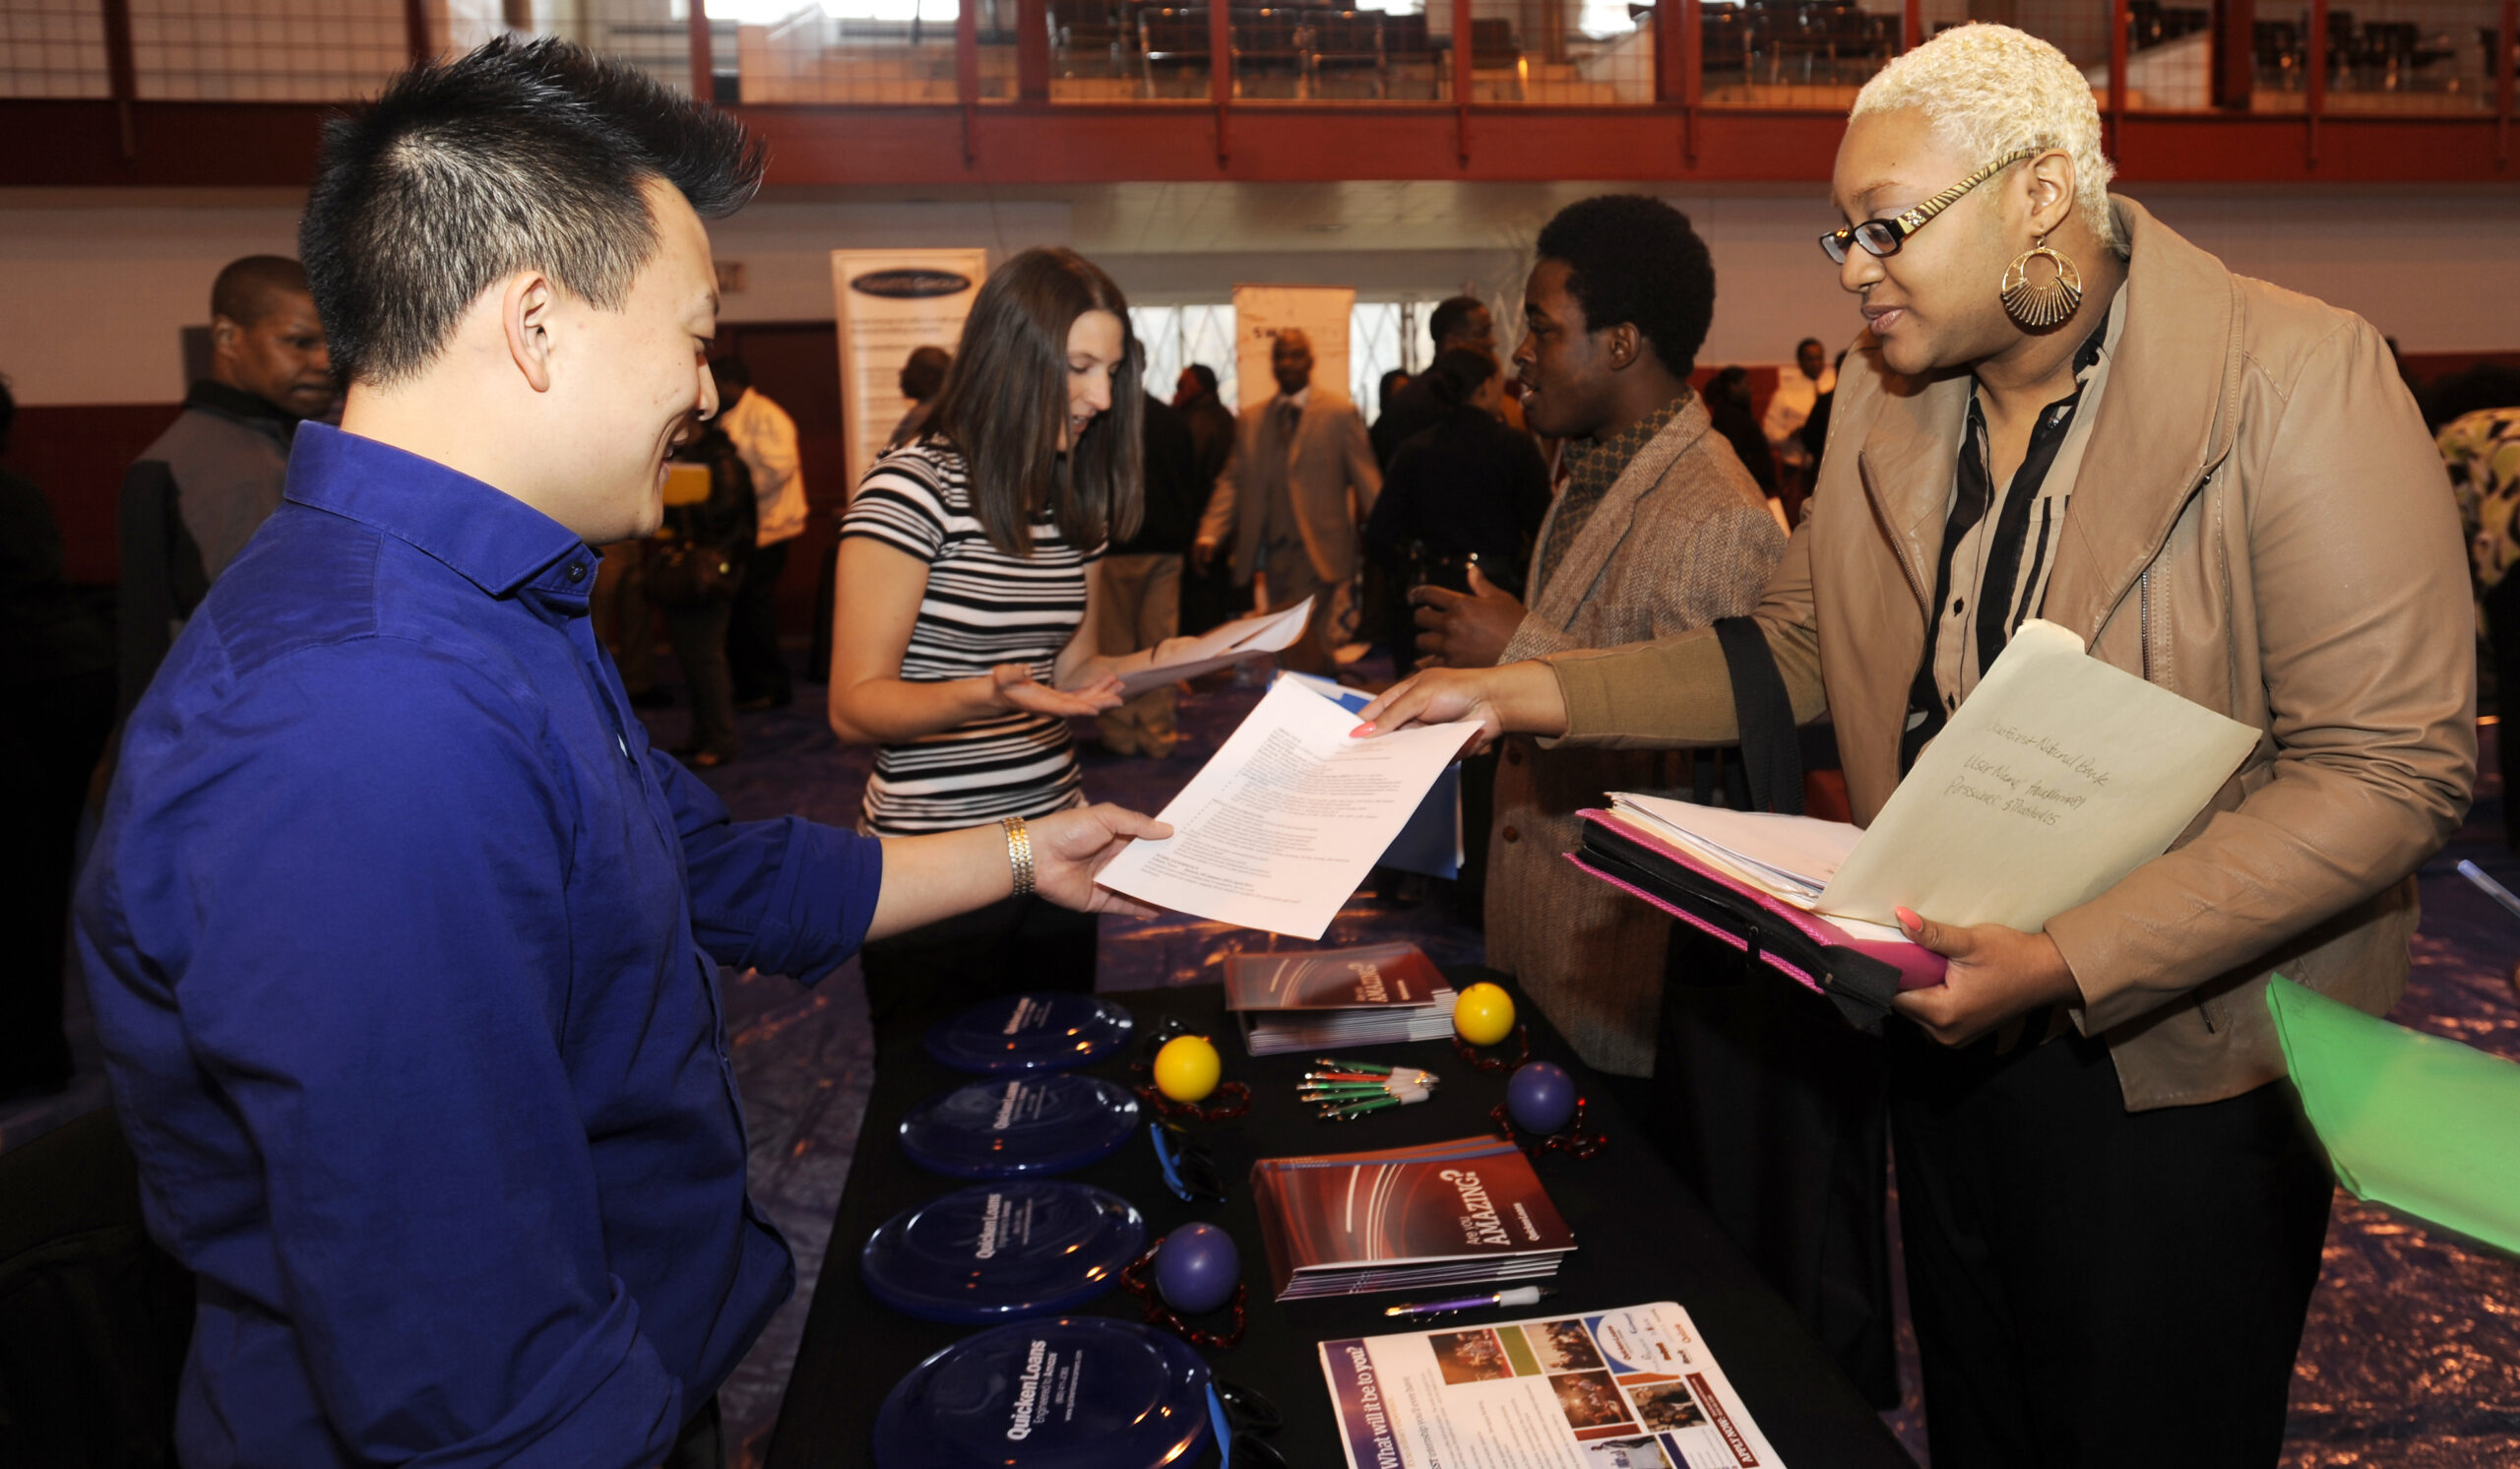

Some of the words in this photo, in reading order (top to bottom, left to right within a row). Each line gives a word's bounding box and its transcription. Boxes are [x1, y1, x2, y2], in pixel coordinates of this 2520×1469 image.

[1439, 1169, 1511, 1245] AMAZING?
[1460, 1216, 1480, 1232] you
[1346, 1346, 1373, 1373] you?
[1357, 1372, 1373, 1385] to
[1361, 1385, 1378, 1403] be
[1362, 1402, 1381, 1412] it
[1365, 1412, 1389, 1437] will
[1373, 1436, 1400, 1469] What
[1731, 1437, 1754, 1463] APPLY
